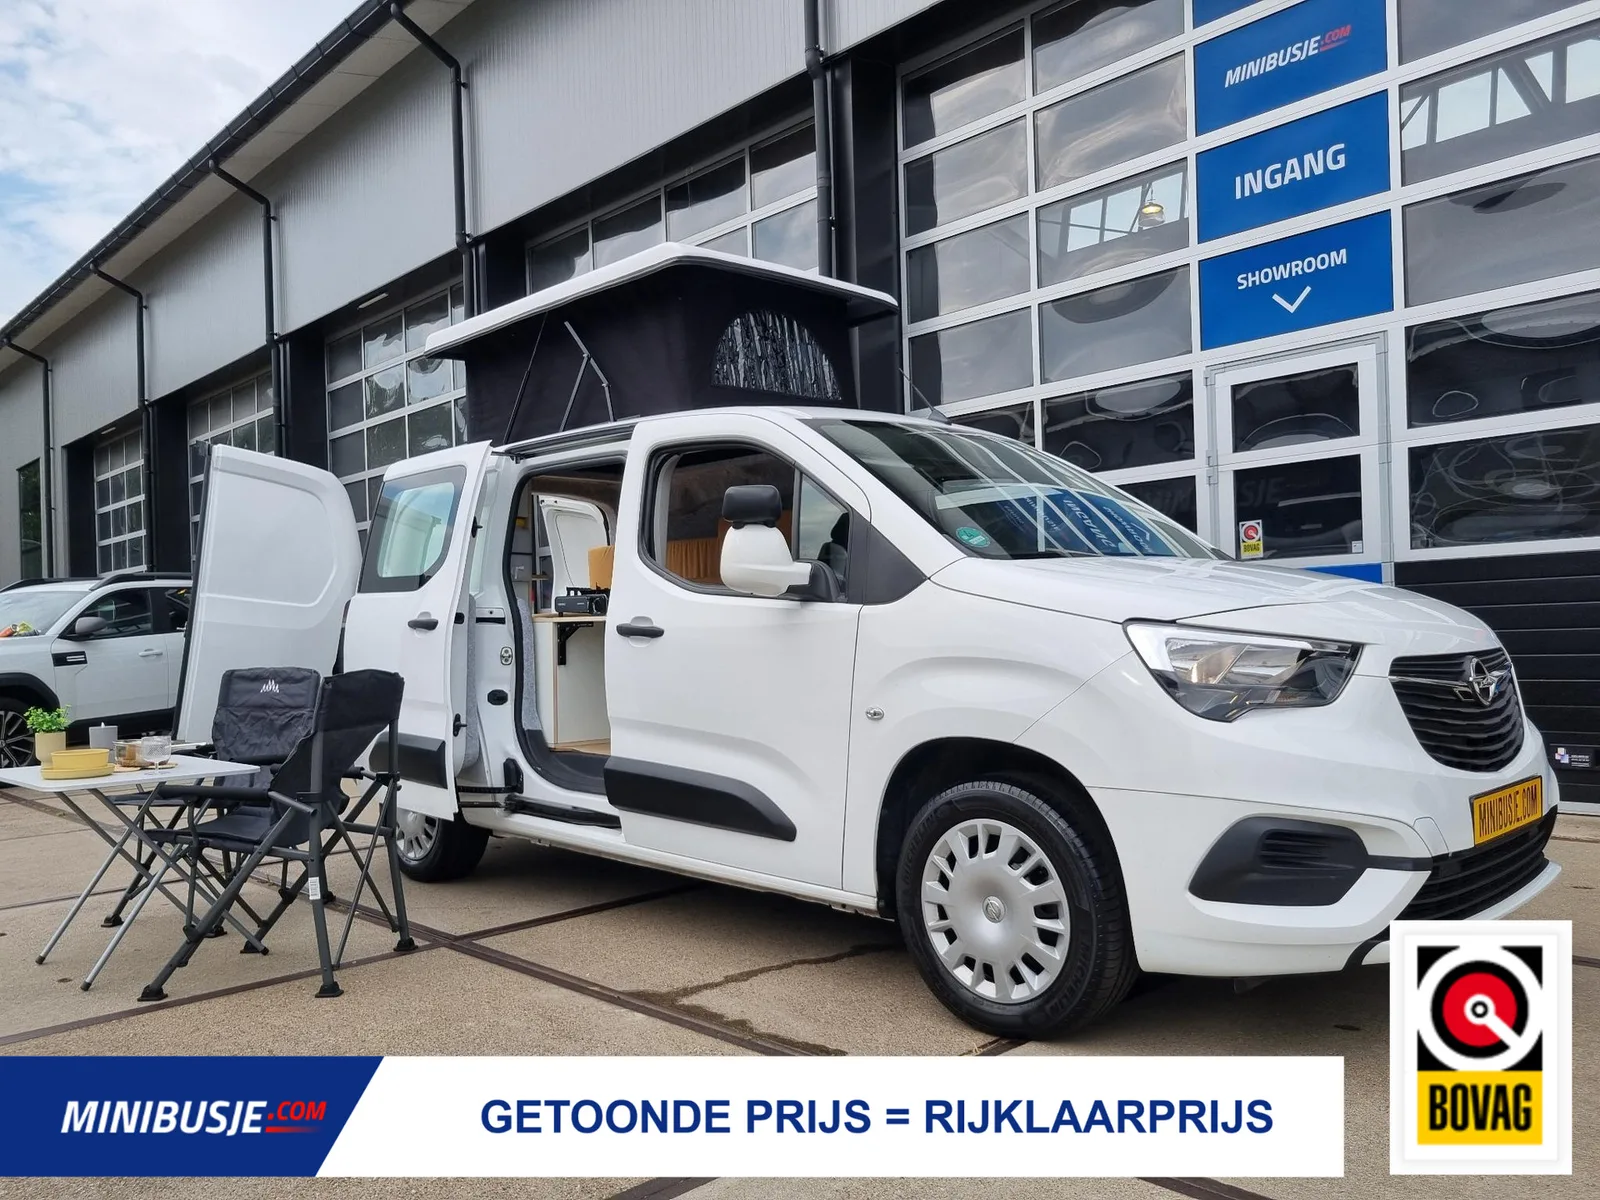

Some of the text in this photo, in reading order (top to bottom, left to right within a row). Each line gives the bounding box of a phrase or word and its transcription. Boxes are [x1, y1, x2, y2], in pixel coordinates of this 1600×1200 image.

[1234, 143, 1346, 200] INGANG
[1236, 248, 1347, 290] SHOWROOM
[1243, 543, 1260, 553] BOVAG
[1479, 784, 1538, 838] MINIBUSJE.COM
